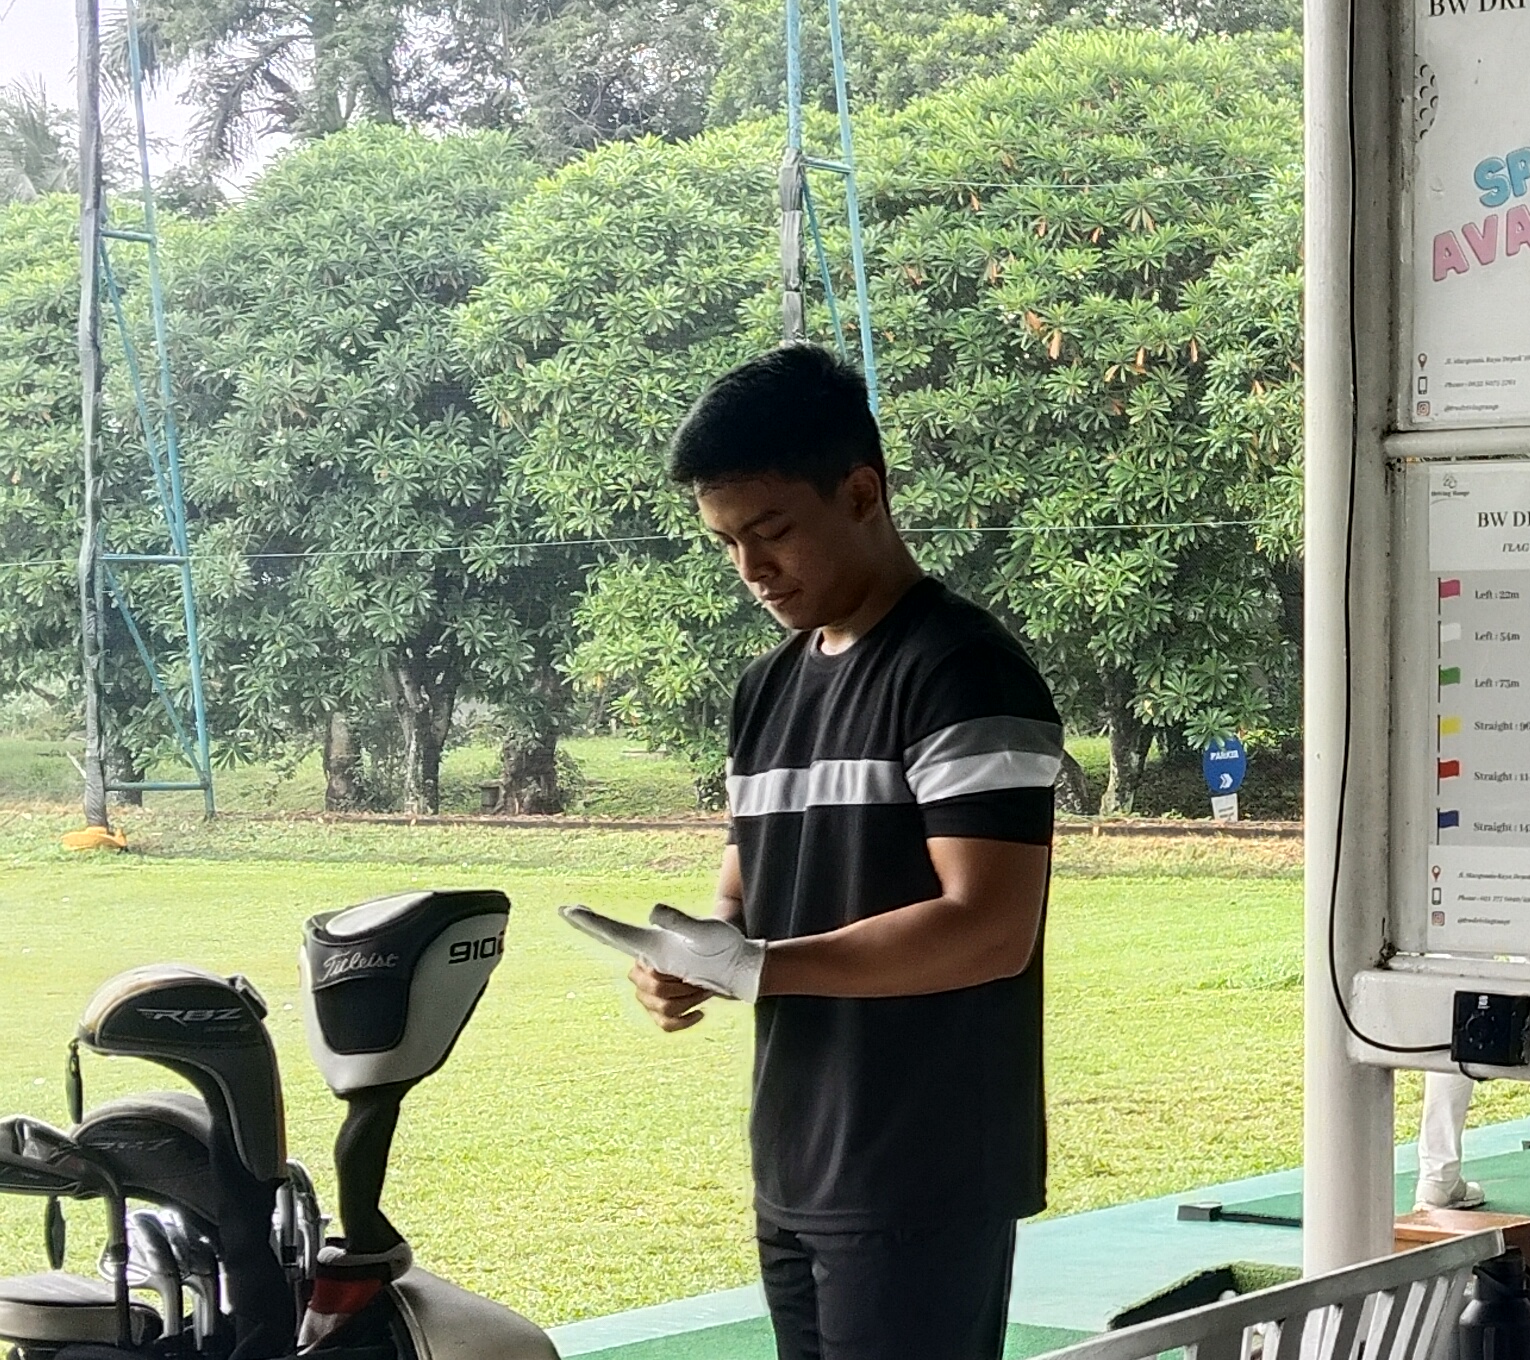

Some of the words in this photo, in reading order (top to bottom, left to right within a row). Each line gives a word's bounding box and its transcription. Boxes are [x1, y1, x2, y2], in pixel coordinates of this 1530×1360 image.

[1477, 511, 1508, 528] BW
[1502, 543, 1530, 553] FLAG
[1475, 590, 1492, 599] Left
[1475, 631, 1493, 641] Left
[1475, 678, 1492, 688] Left
[1474, 721, 1513, 732] Straight
[1474, 771, 1512, 783] Straight
[1473, 822, 1512, 833] Straight
[319, 951, 399, 982] Titleist
[136, 1007, 243, 1027] RBZ
